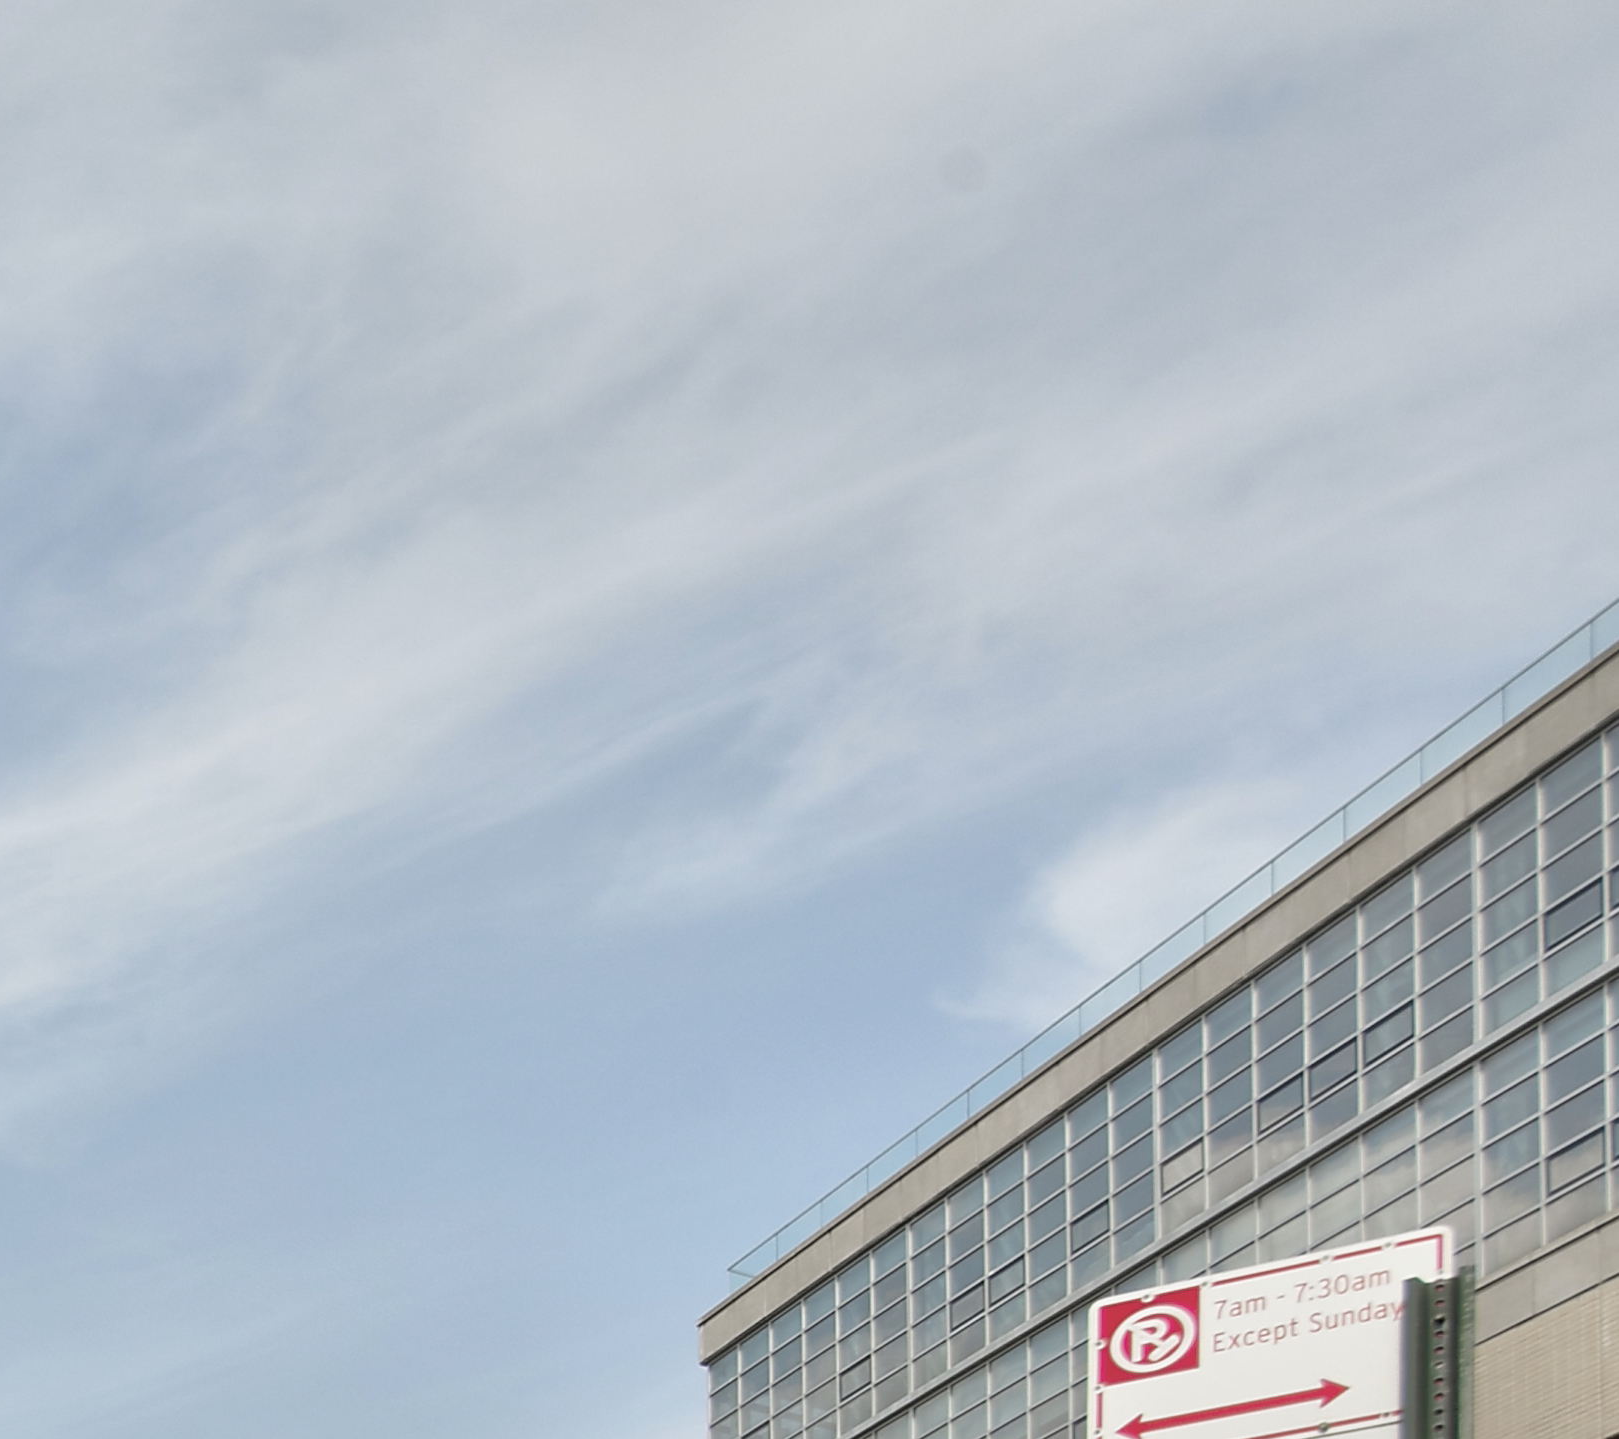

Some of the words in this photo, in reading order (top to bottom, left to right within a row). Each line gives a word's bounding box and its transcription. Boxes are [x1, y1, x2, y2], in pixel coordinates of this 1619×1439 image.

[1214, 1294, 1267, 1320] 7am
[1294, 1269, 1391, 1303] 7:30am
[1212, 1319, 1299, 1353] Except
[1309, 1299, 1405, 1333] Sunday
